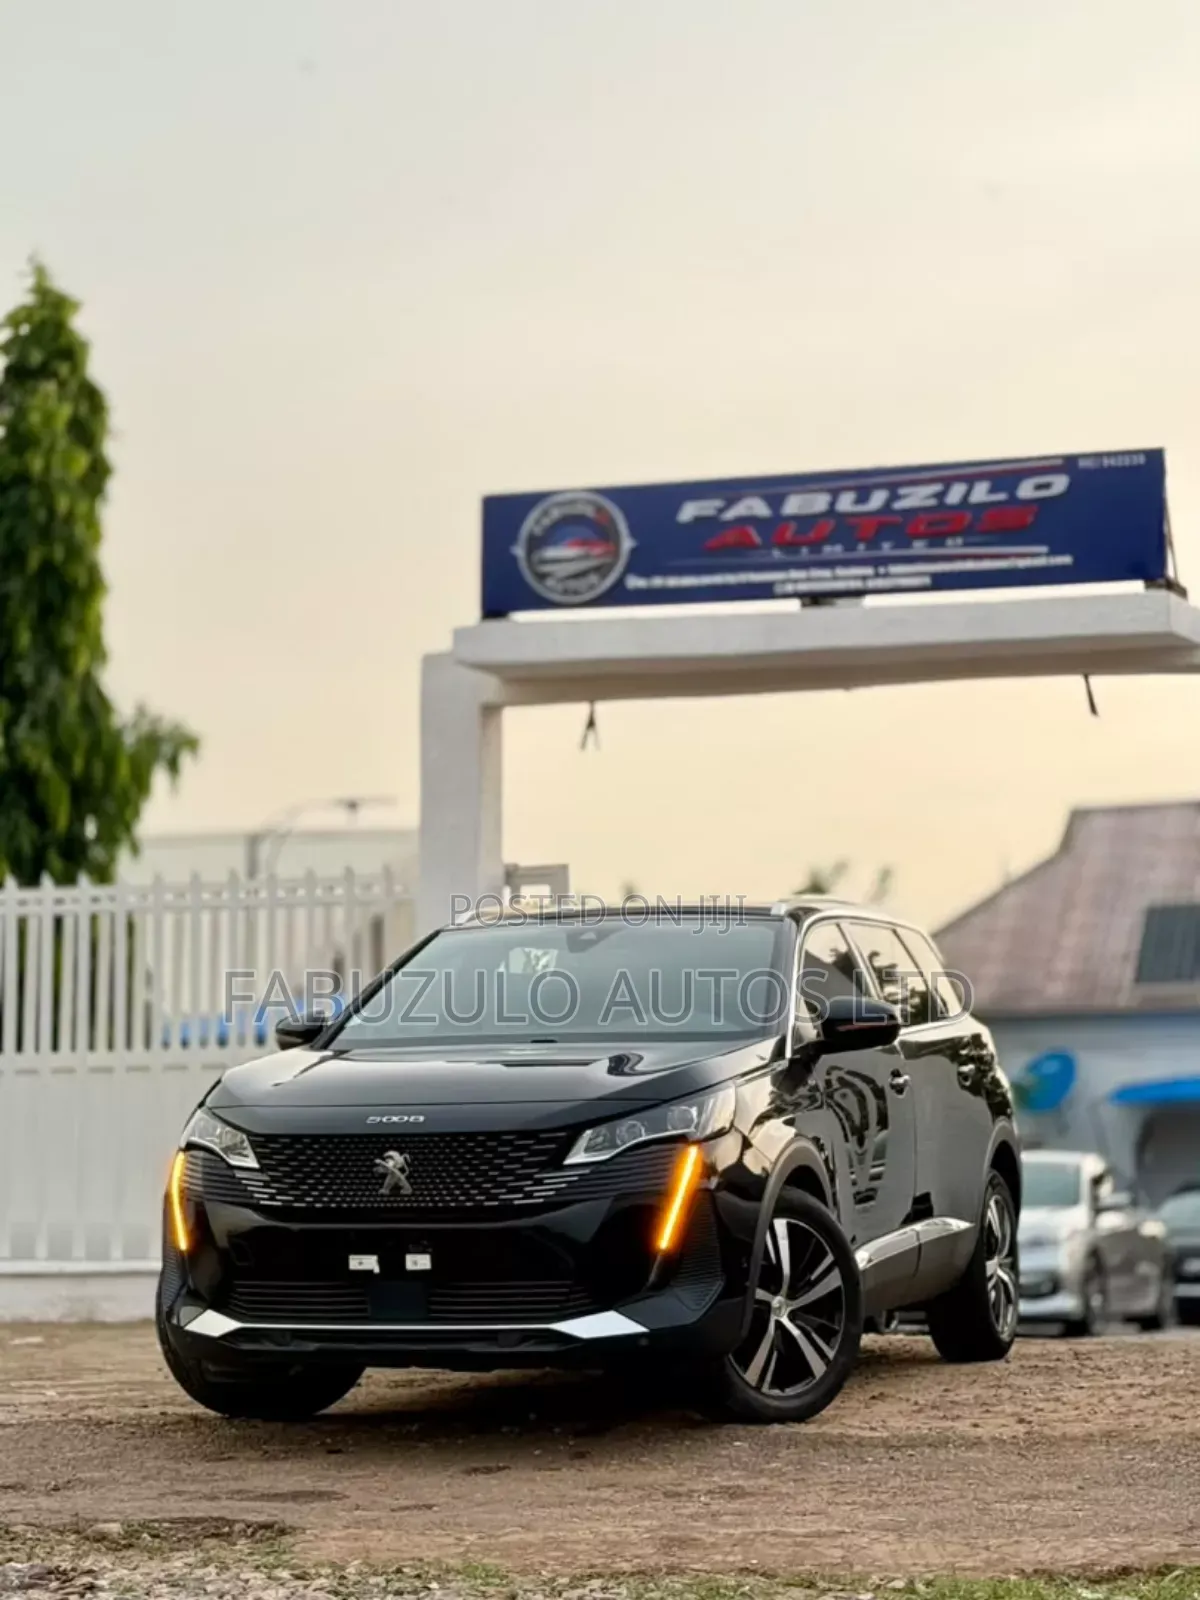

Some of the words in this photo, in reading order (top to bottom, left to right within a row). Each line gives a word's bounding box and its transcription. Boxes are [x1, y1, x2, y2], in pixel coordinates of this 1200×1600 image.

[676, 473, 1070, 525] FABUZILO
[704, 504, 1038, 551] AUTOS
[365, 1115, 425, 1124] 5008
